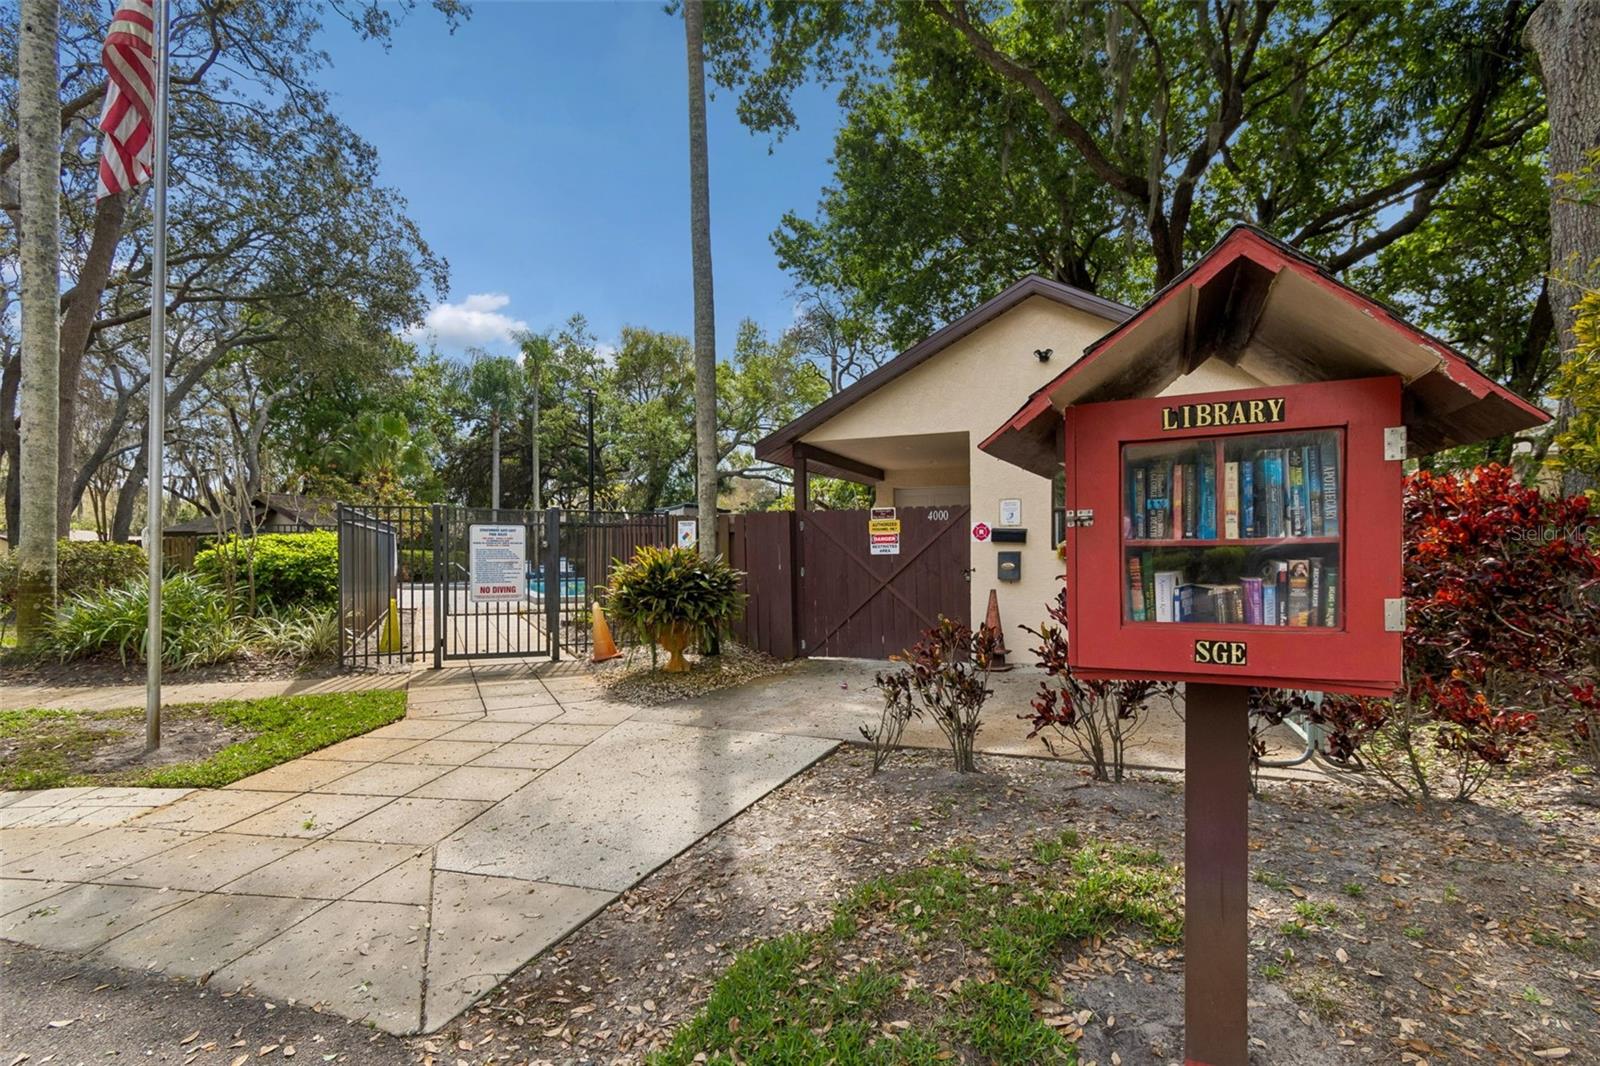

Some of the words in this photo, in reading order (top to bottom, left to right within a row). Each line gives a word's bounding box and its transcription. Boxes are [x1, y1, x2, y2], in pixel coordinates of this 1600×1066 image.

[1162, 398, 1285, 430] LIBRARY
[1323, 464, 1337, 520] APOTHECARY
[927, 510, 949, 521] 4000
[1195, 640, 1246, 665] SGE
